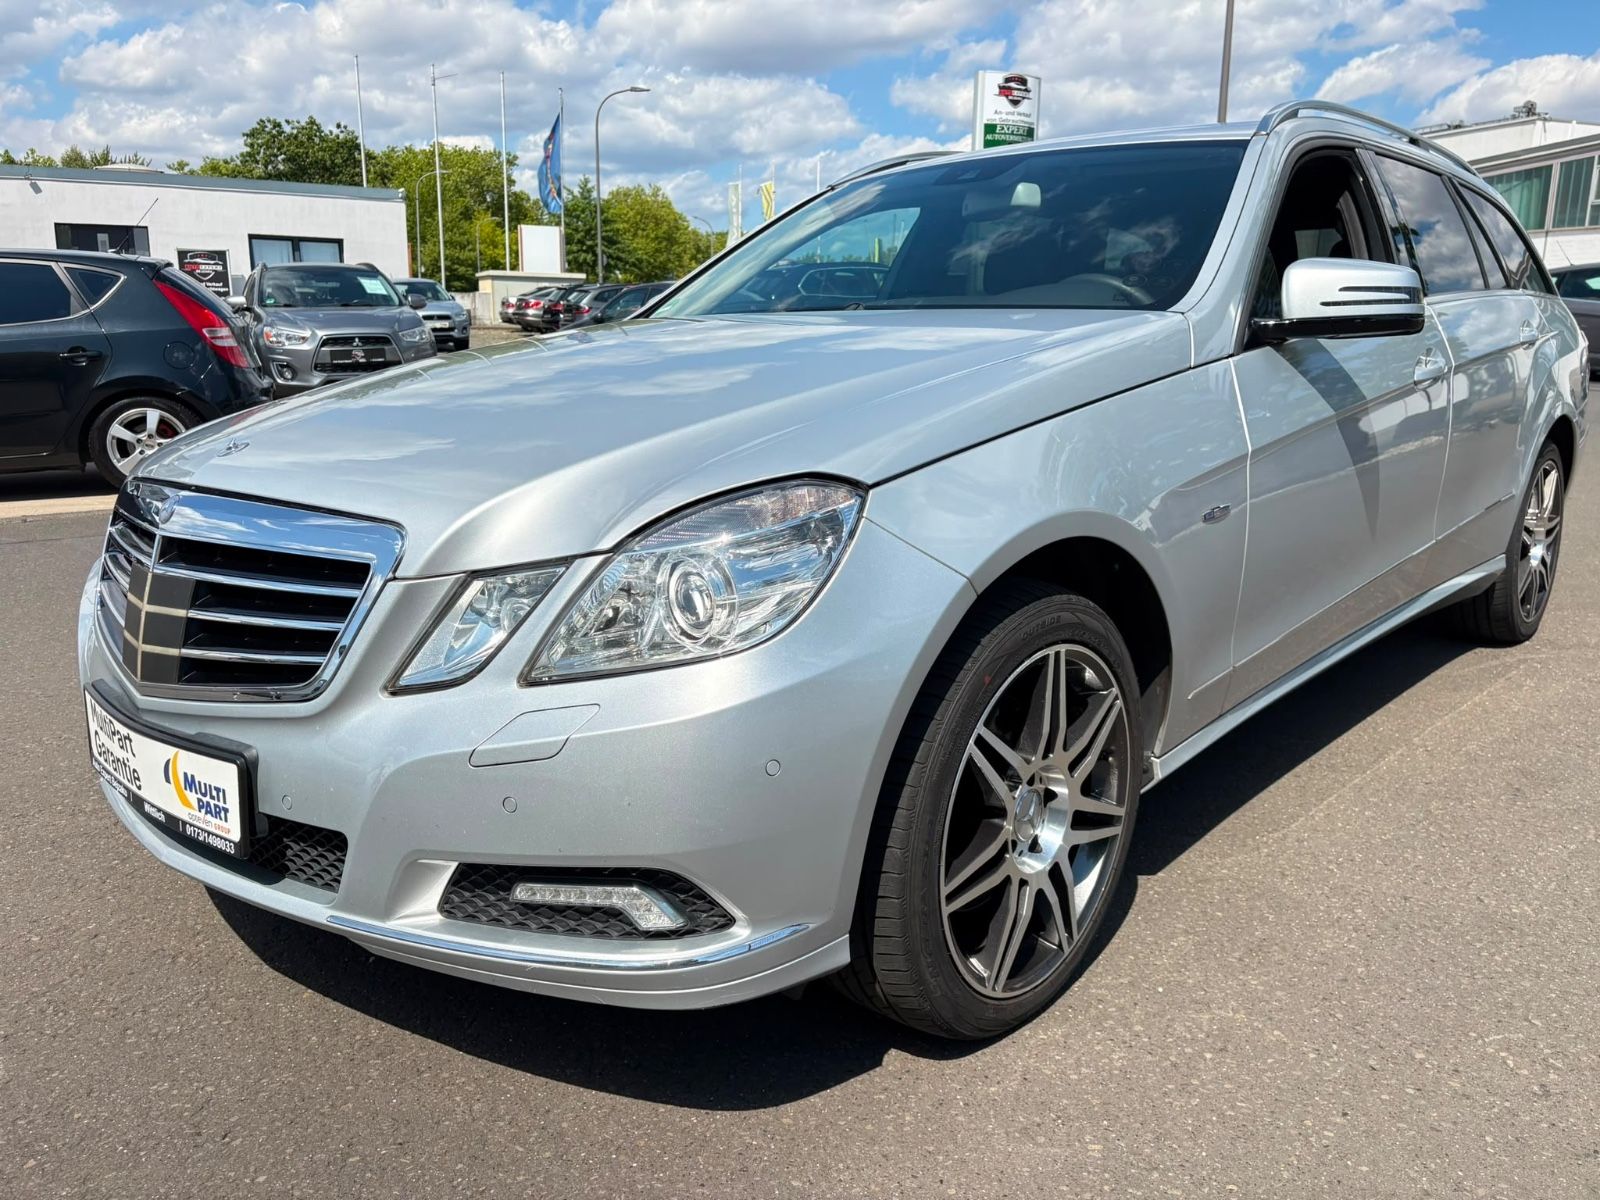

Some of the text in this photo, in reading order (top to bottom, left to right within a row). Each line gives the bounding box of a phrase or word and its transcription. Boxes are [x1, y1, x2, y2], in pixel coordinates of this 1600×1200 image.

[995, 124, 1029, 135] EXPERT
[90, 697, 137, 758] MultiPart
[94, 729, 142, 791] Garantie
[183, 771, 227, 805] MULTI
[196, 797, 230, 823] PART
